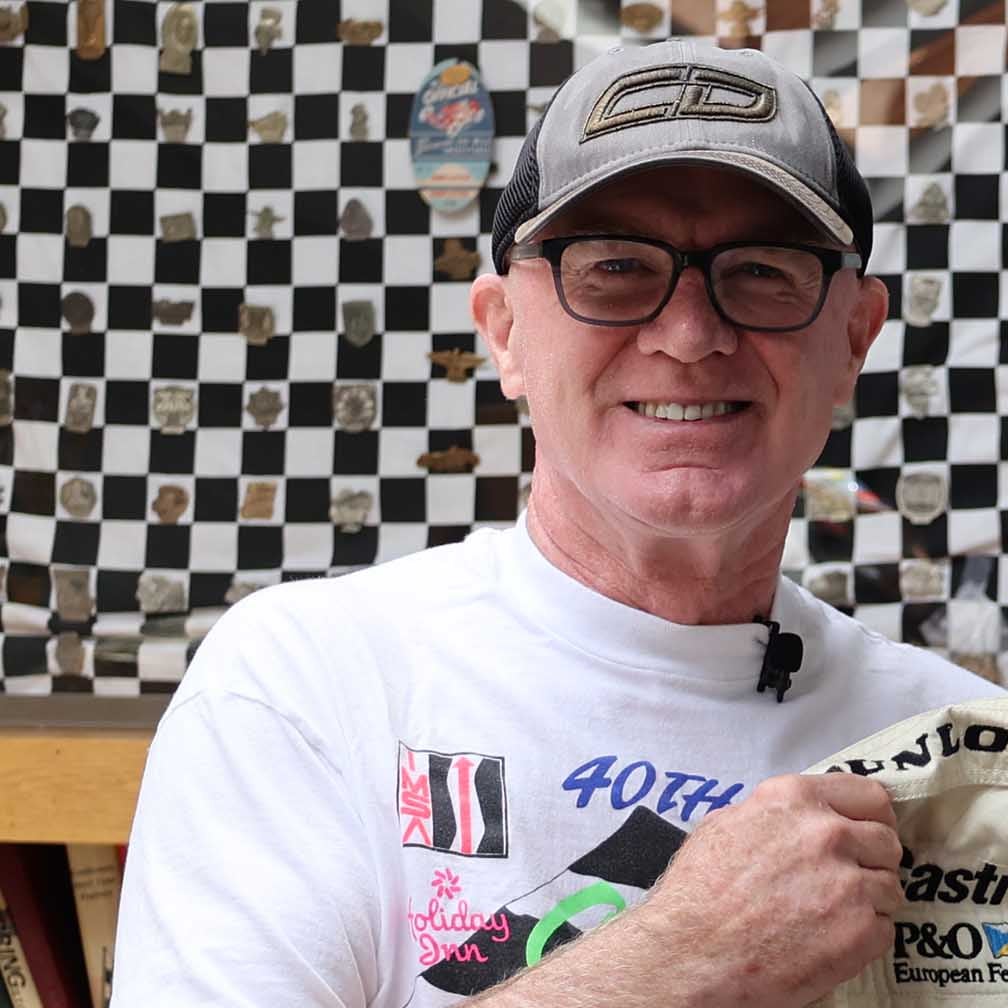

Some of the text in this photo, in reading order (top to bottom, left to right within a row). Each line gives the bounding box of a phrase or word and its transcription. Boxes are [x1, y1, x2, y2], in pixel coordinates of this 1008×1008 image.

[562, 755, 745, 821] 40TH
[408, 898, 509, 942] oliday
[419, 933, 488, 965] Inn
[894, 922, 983, 960] P&O
[894, 962, 984, 987] European
